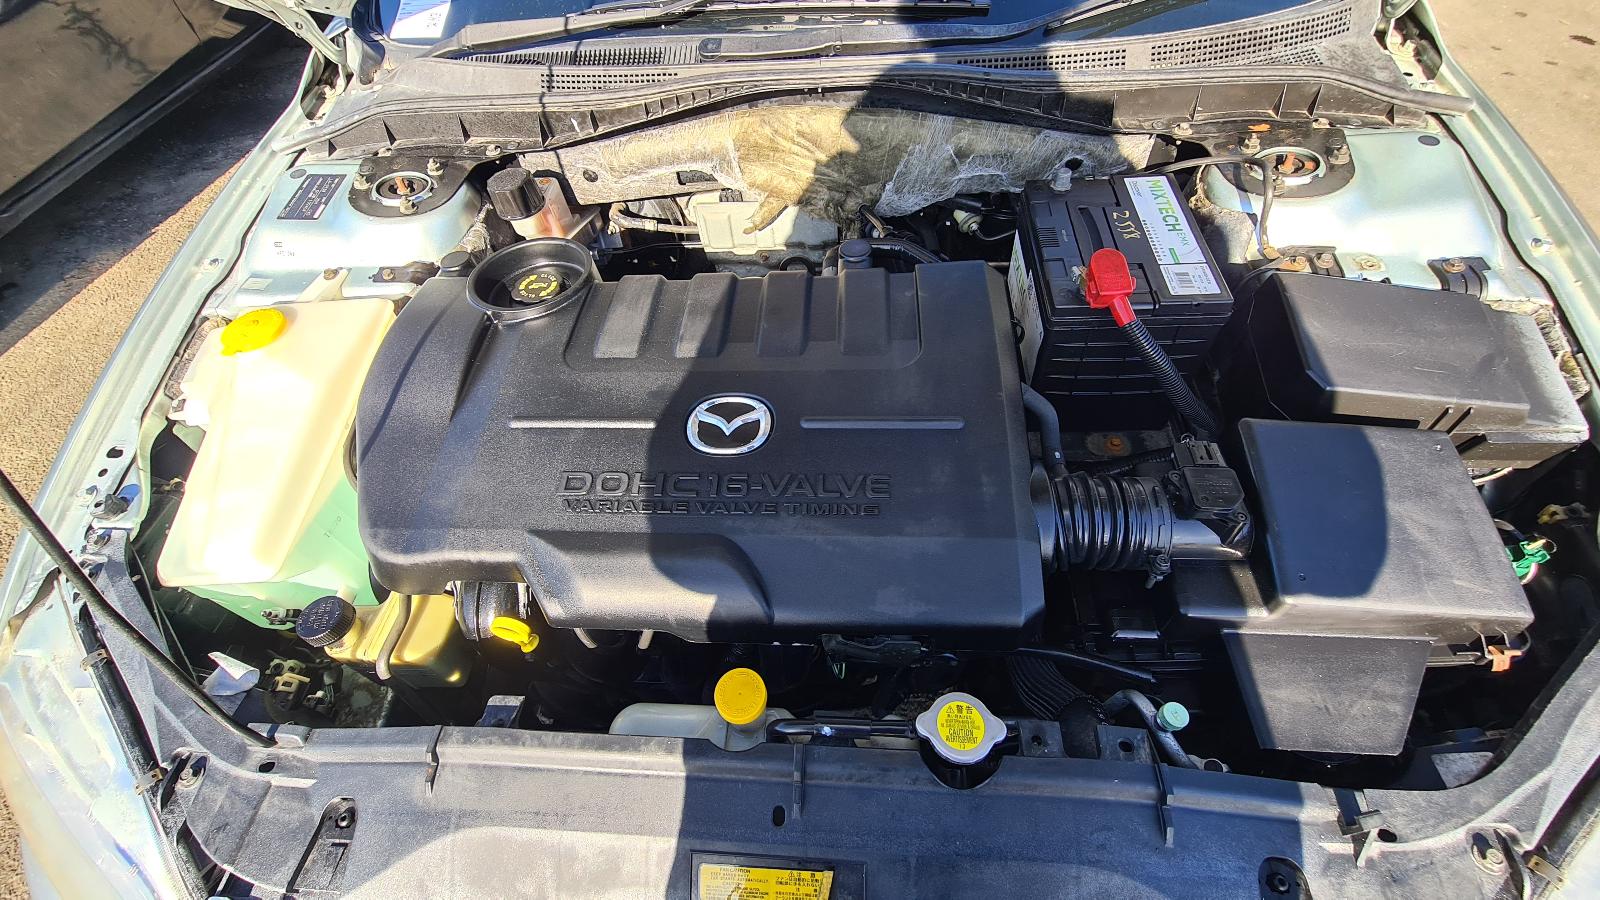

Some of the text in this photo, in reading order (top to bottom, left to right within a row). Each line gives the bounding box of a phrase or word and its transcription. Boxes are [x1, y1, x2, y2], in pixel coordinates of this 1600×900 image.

[1145, 179, 1184, 232] MIXTECH
[1176, 232, 1191, 247] EMX
[556, 470, 892, 499] DOHC 16-VALVE
[562, 499, 880, 516] VARIABLE VALVE TIMING
[948, 728, 974, 737] CAUTION
